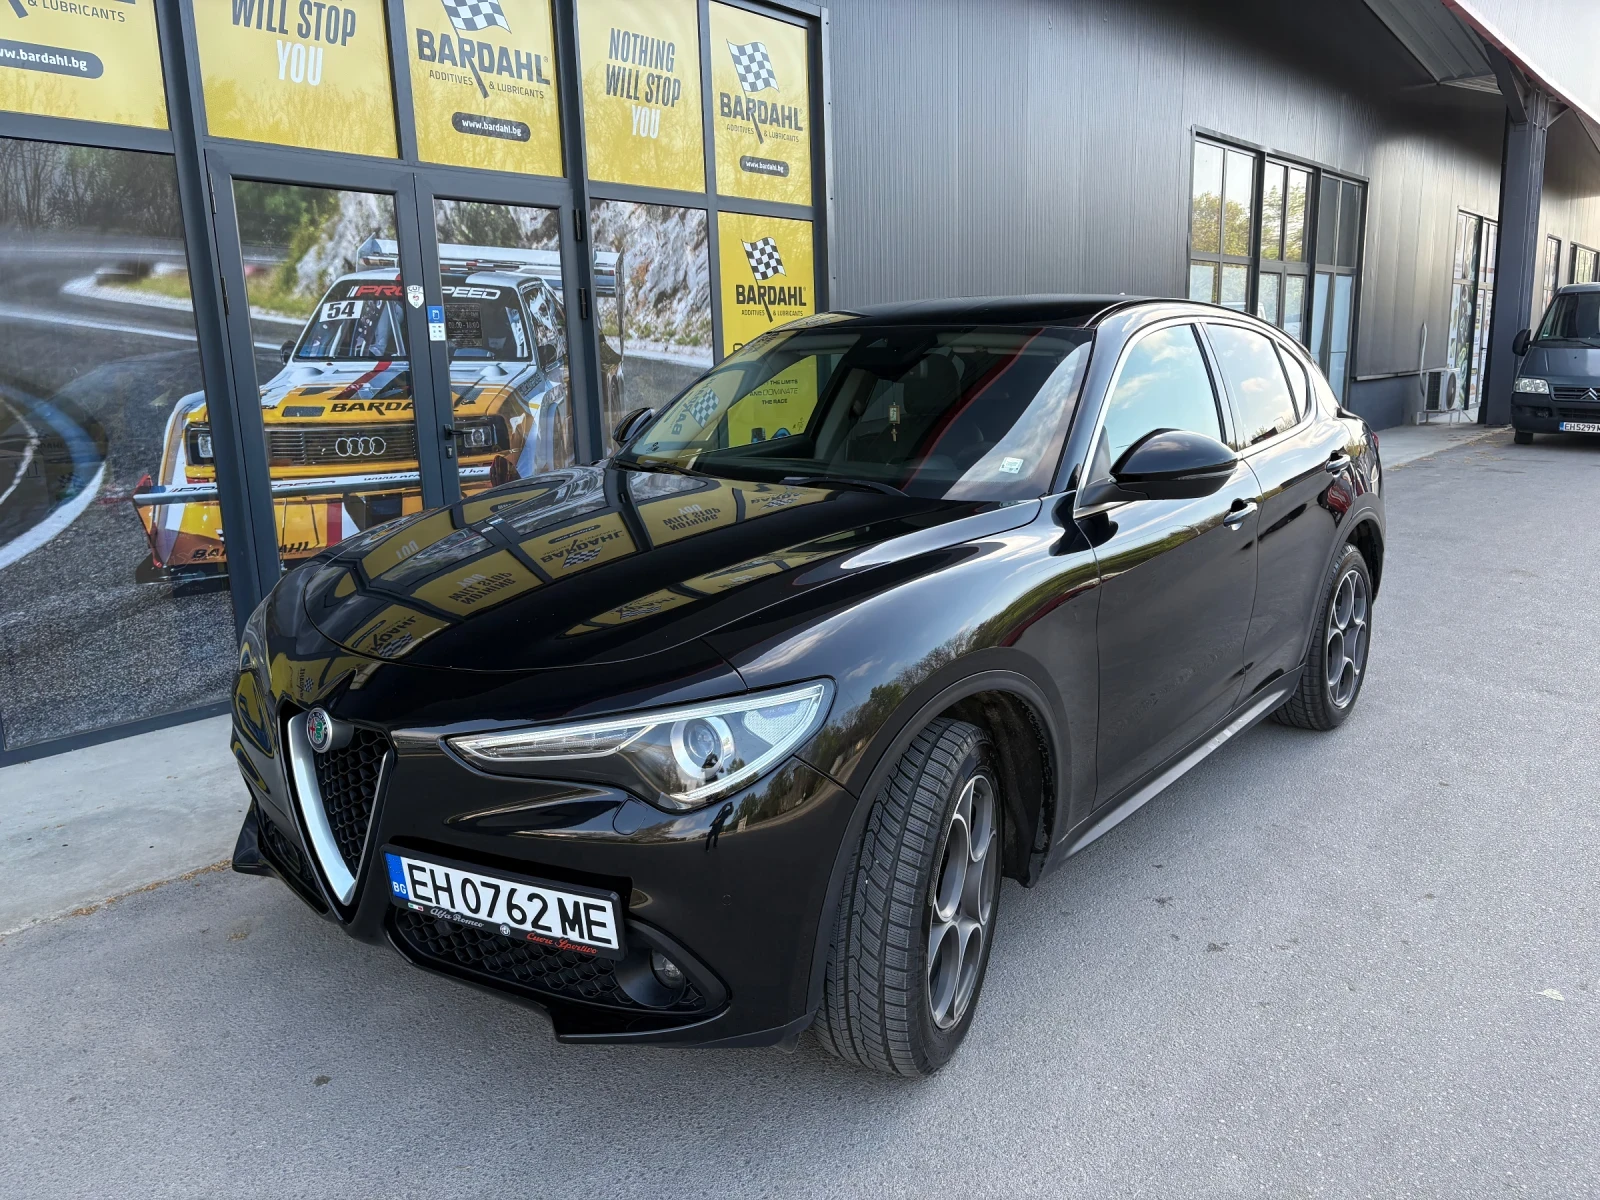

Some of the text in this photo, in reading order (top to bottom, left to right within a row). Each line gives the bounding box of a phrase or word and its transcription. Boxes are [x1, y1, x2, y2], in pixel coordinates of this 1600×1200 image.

[43, 0, 126, 23] LUBRICANTS
[231, 0, 356, 47] WILL STOP
[608, 27, 676, 73] NOTHING
[276, 39, 324, 86] YOU
[429, 69, 545, 99] ADDITIVES & LUBRICANTS
[606, 63, 681, 108] WILL STOP
[461, 119, 522, 137] www.bardahl.bg
[631, 104, 661, 139] YOU
[726, 123, 755, 135] ADDITIVES
[768, 131, 800, 143] LUBRICANTS
[745, 160, 784, 174] www.bardahl.bg
[327, 302, 356, 319] 54
[762, 387, 799, 396] DOMINATE
[330, 401, 413, 416] BARDA
[392, 882, 408, 895] BG
[430, 907, 485, 928] Alfa Romeo
[526, 932, 599, 955] Cuore Sportivo
